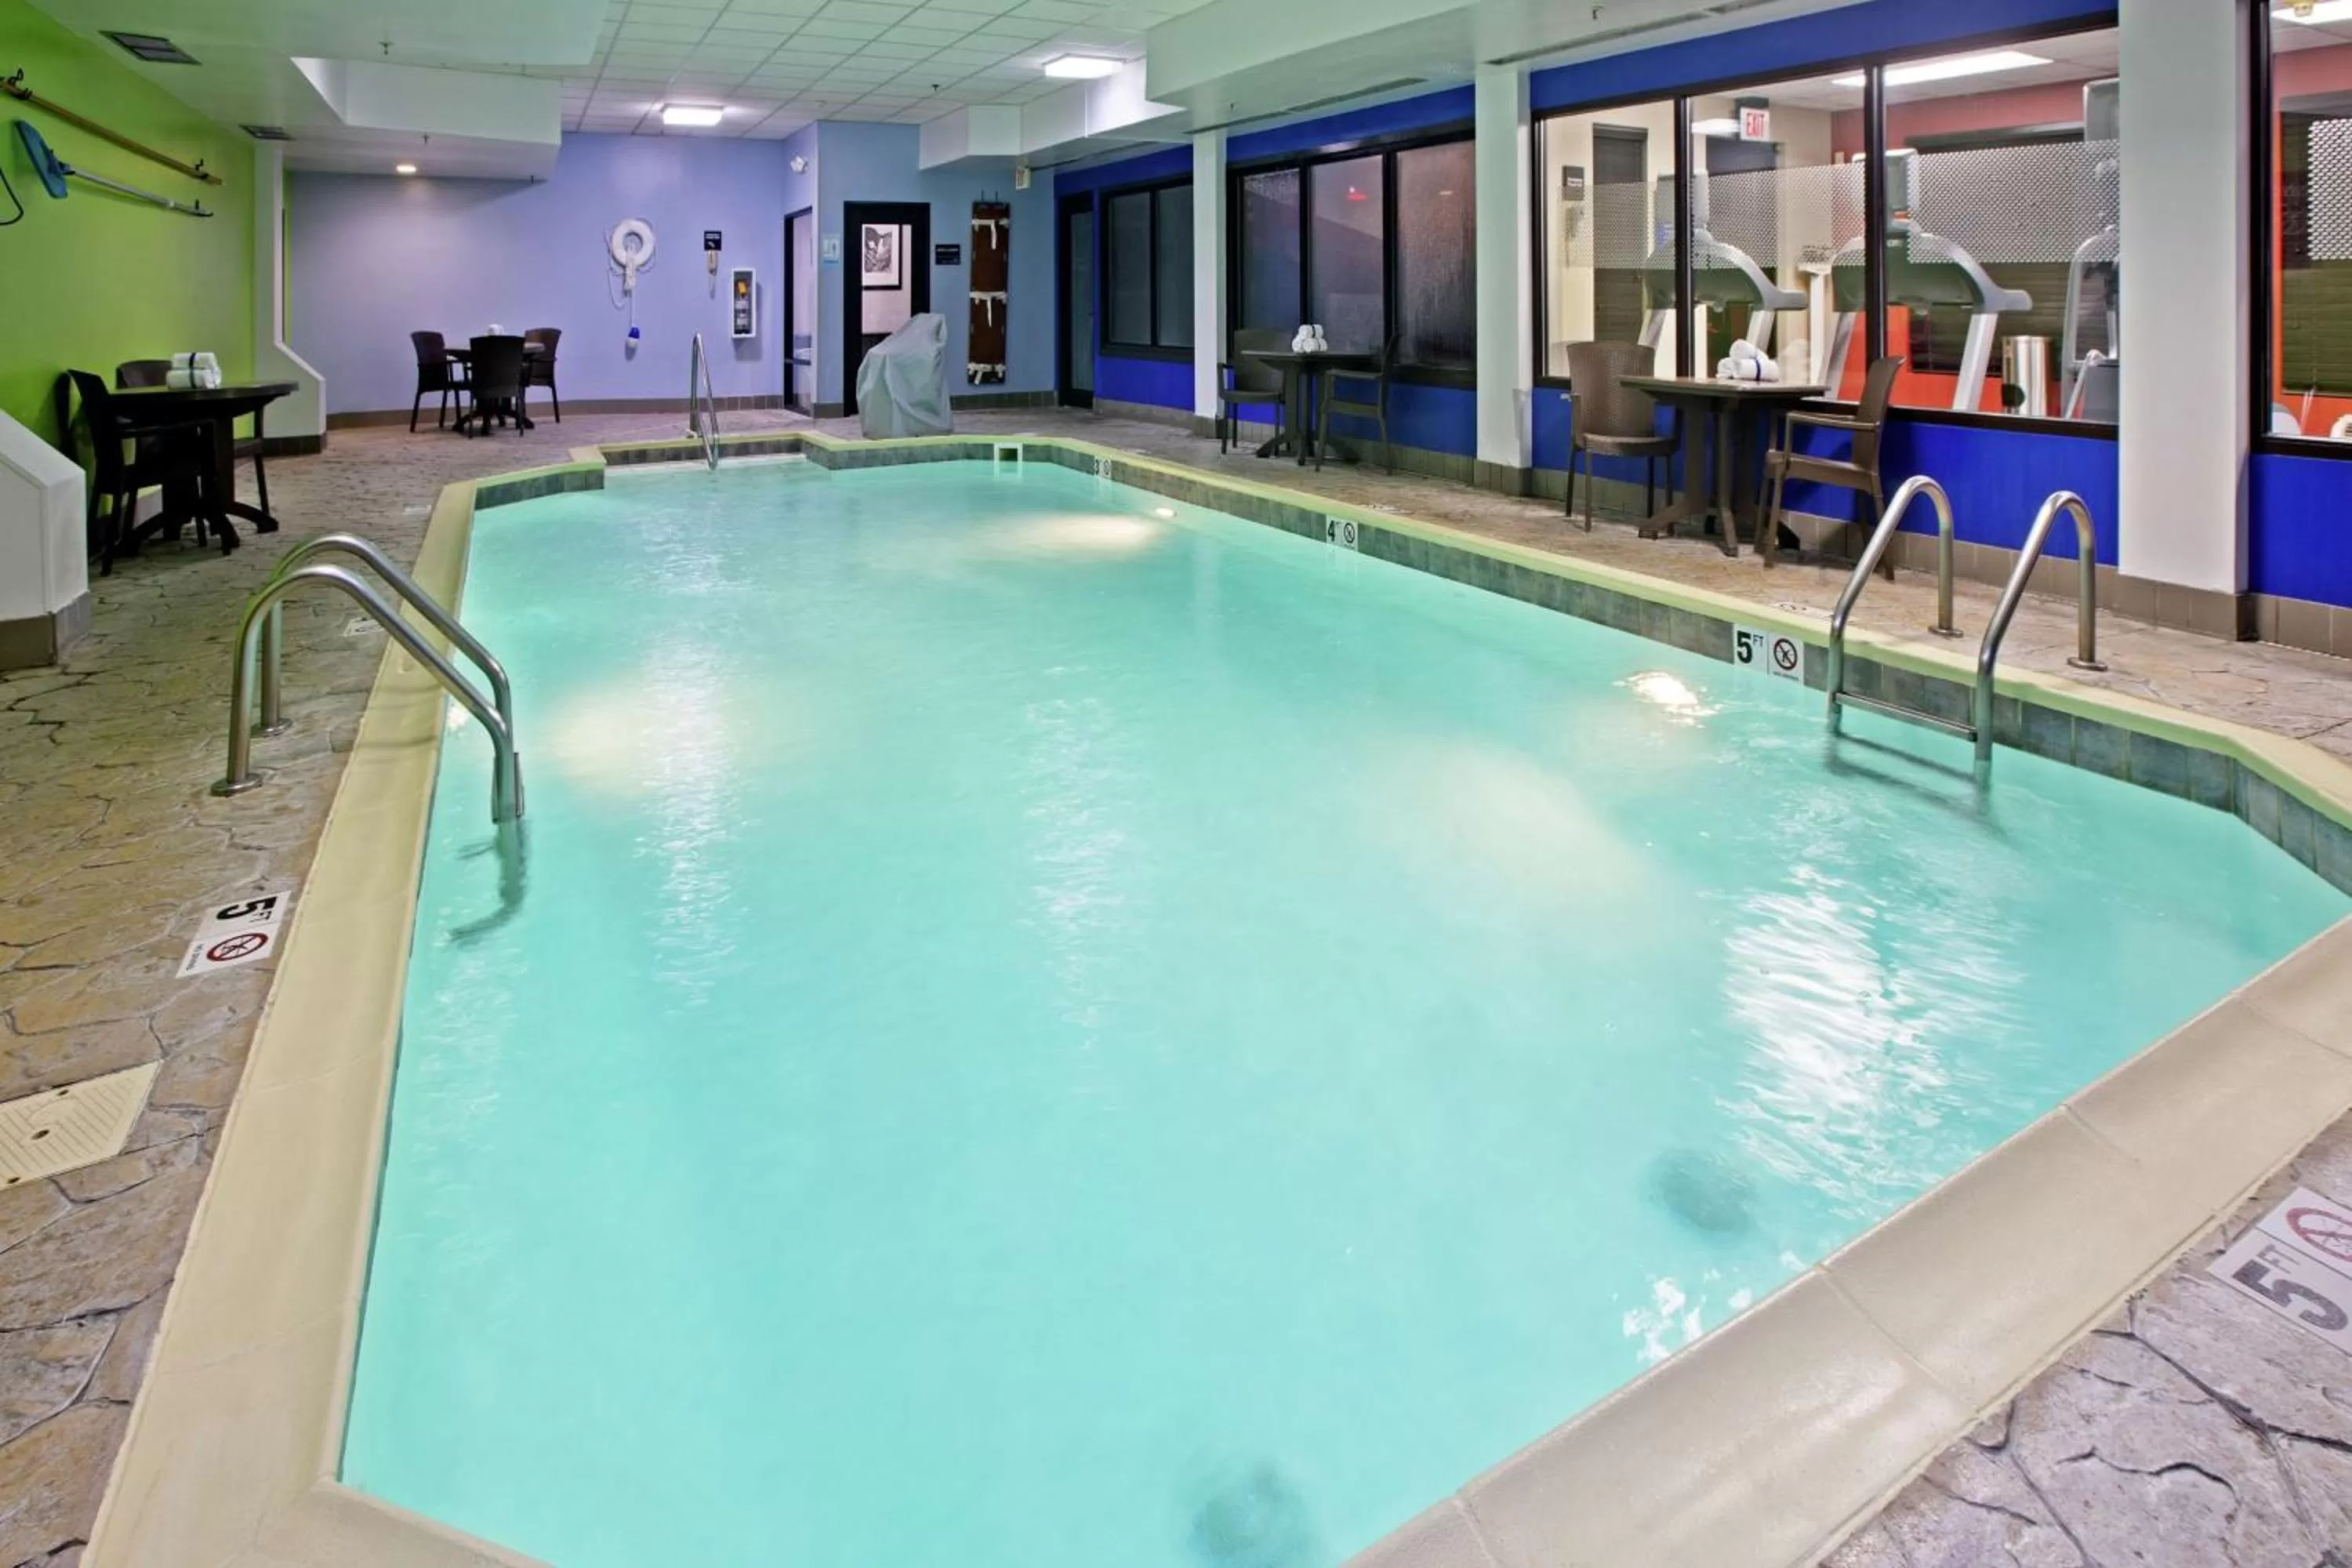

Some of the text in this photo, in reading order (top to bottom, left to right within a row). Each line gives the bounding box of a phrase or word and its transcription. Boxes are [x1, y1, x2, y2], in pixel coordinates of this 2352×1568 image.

[1327, 520, 1335, 542] 4
[1737, 630, 1764, 664] 5 FT
[216, 896, 278, 920] 5
[2232, 1243, 2348, 1331] 5 FT
